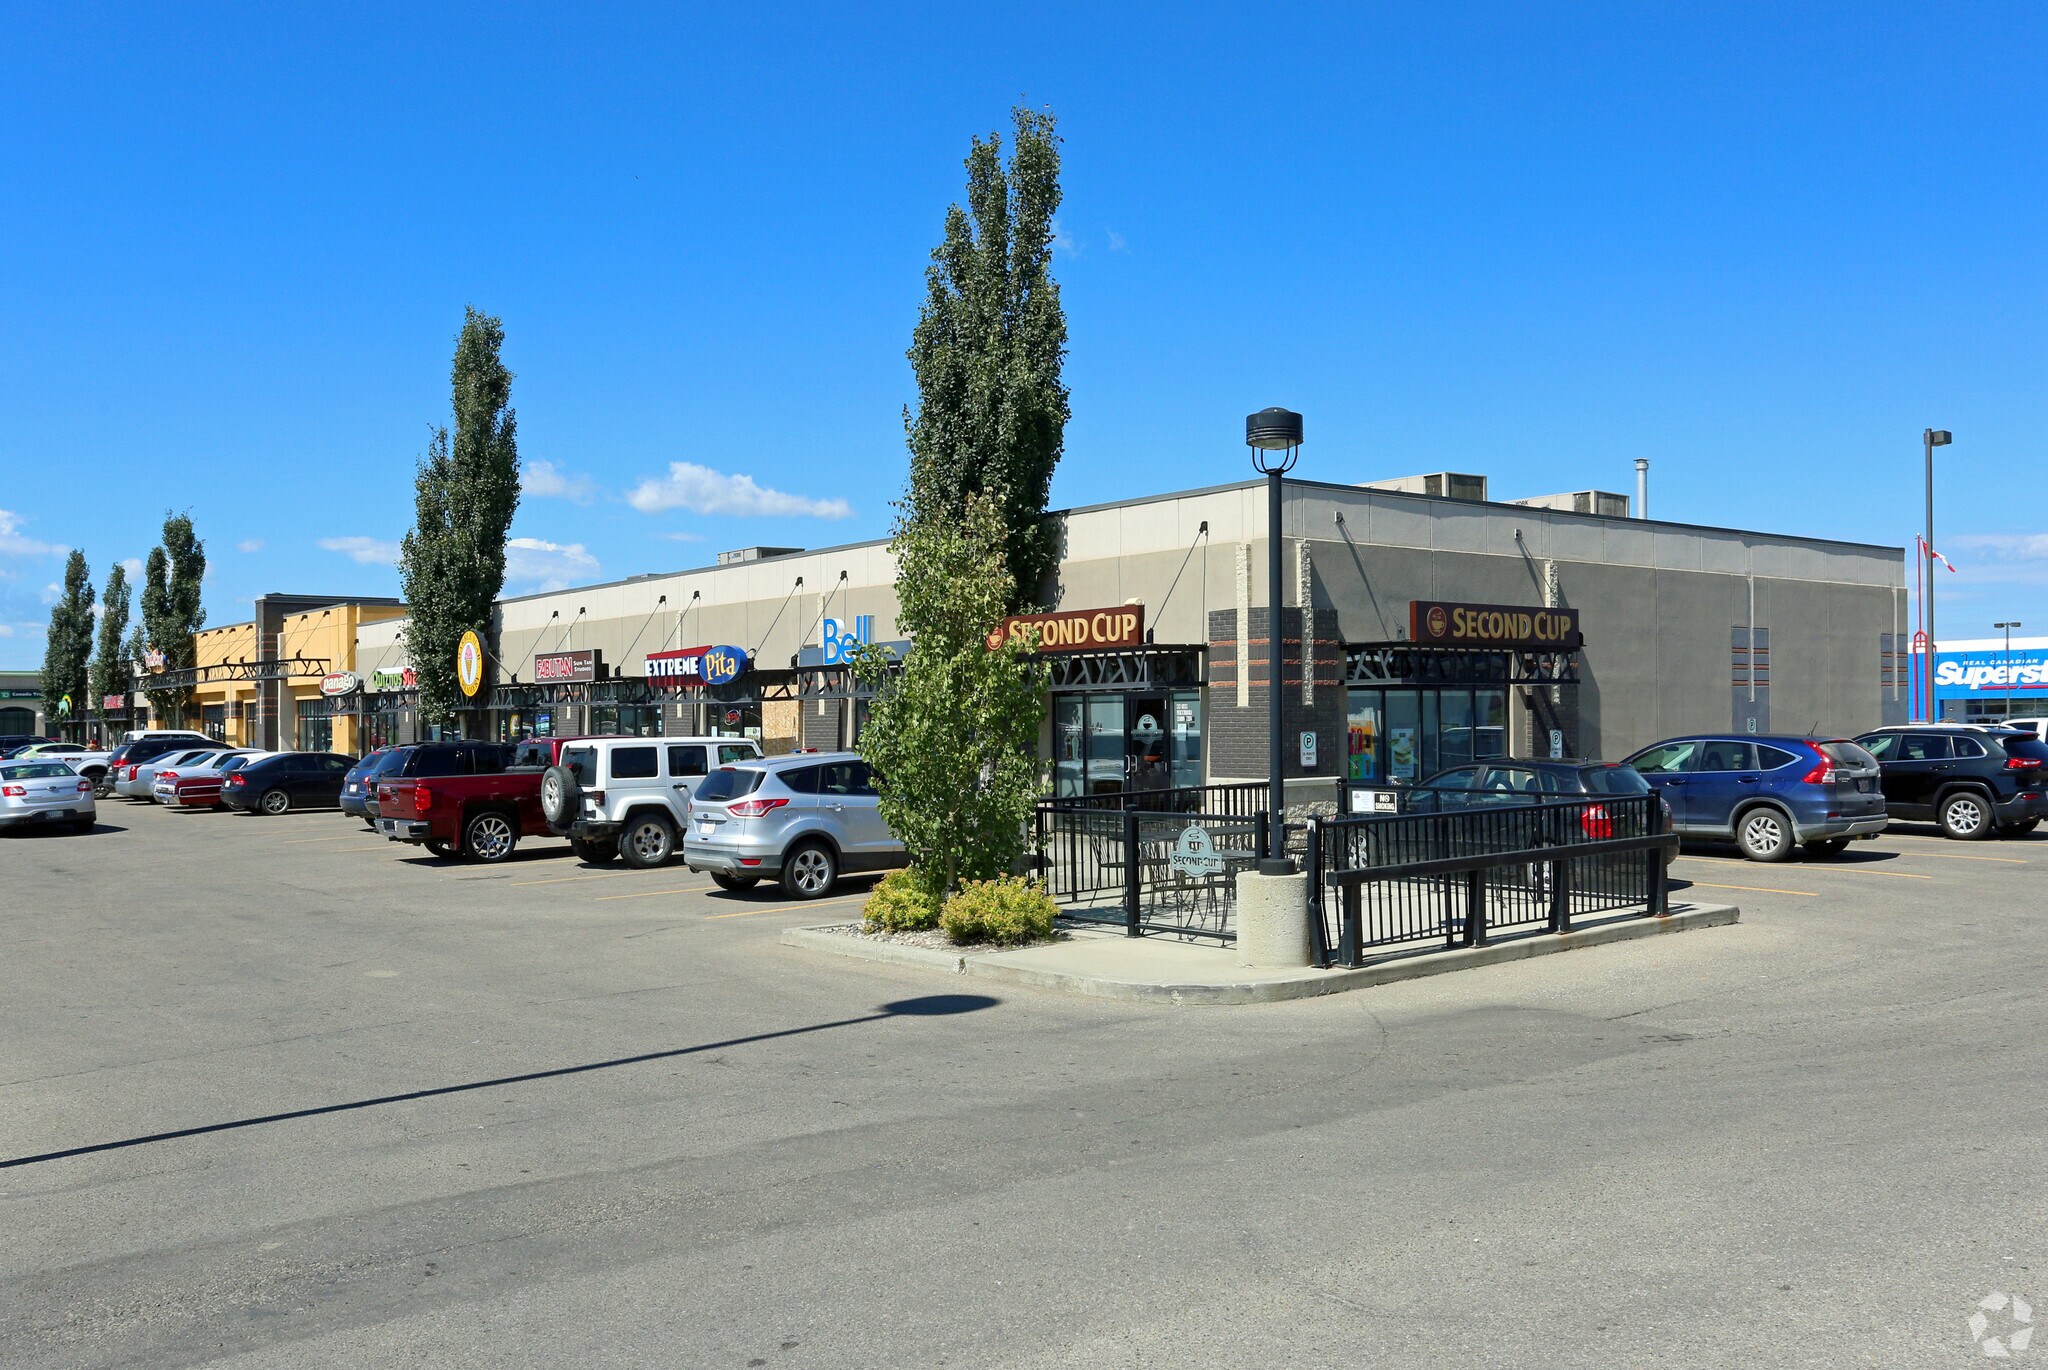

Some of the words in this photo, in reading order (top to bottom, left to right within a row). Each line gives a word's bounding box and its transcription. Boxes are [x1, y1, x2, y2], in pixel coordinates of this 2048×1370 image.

[1092, 612, 1137, 642] CUP
[1452, 607, 1532, 639] SECOND
[1534, 611, 1572, 641] CUP
[823, 615, 870, 665] Bell
[536, 656, 573, 679] FABUTAN
[645, 656, 698, 677] EXTREME
[705, 651, 736, 681] Pita
[323, 672, 355, 691] panago
[1379, 794, 1391, 803] NO
[1173, 854, 1203, 866] SECOND
